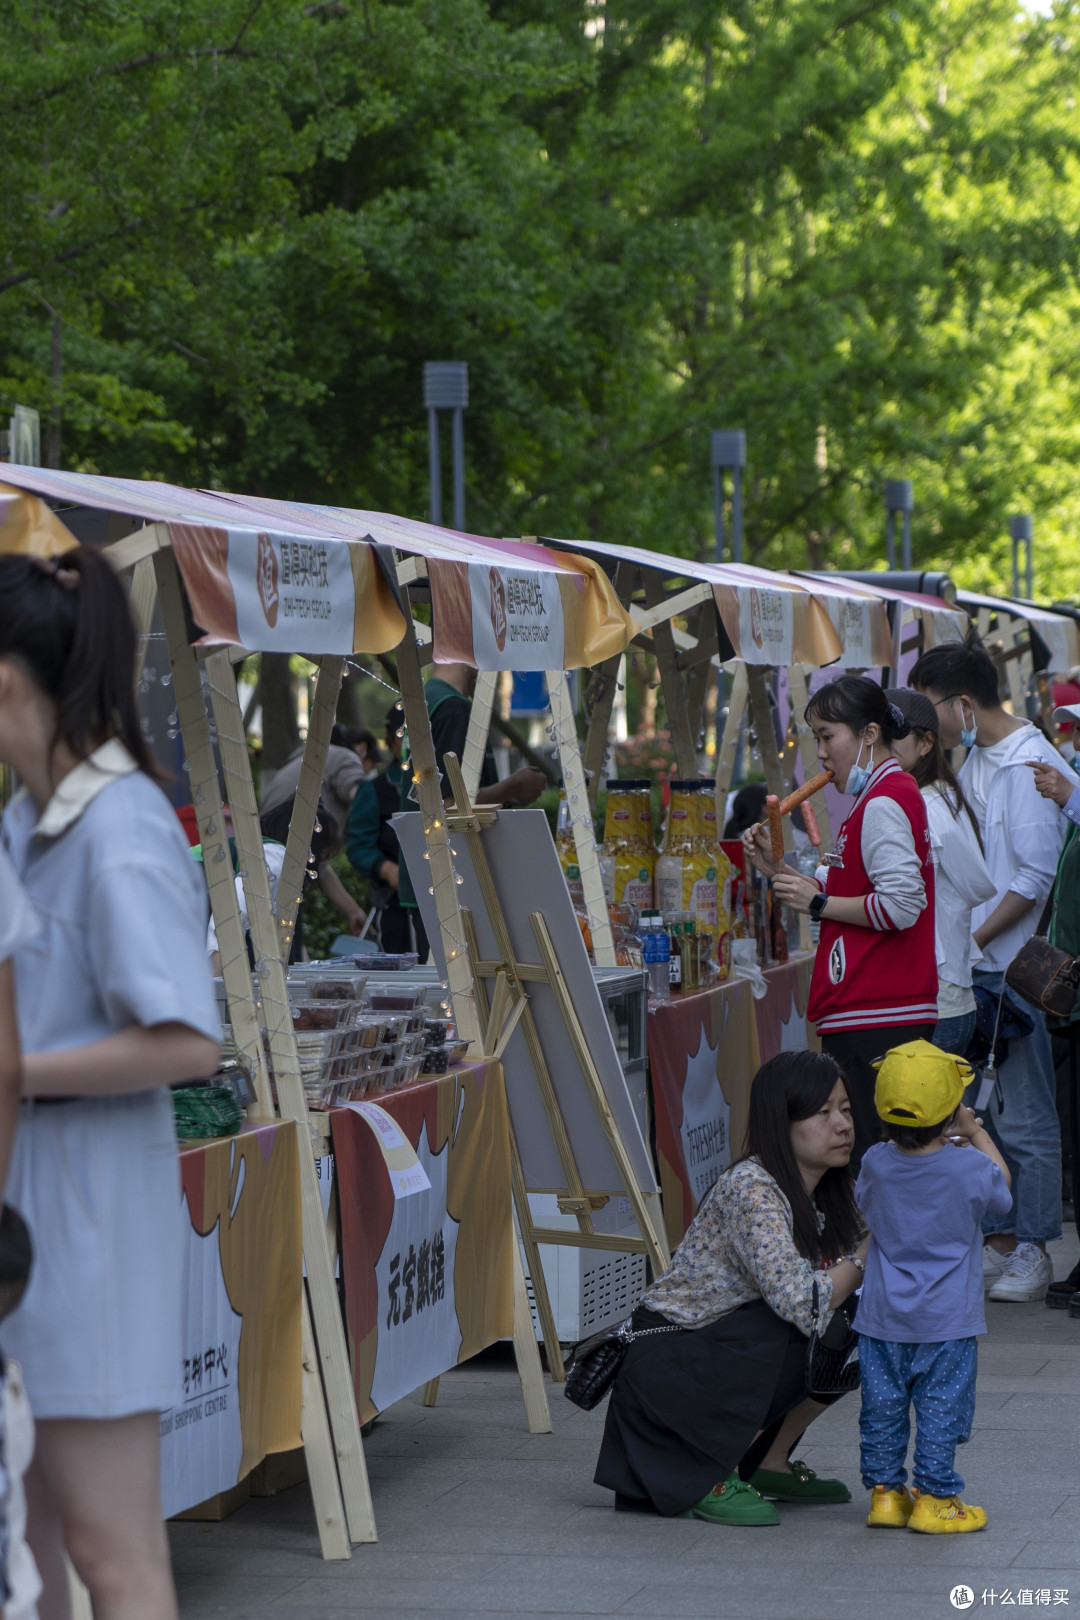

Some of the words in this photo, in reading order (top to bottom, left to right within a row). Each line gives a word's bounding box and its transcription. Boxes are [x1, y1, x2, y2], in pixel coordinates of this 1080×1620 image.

[281, 541, 329, 588] 值得买科技
[283, 597, 311, 619] ZHI-TECH
[311, 599, 332, 620] GROUP
[507, 576, 547, 616] 值得买科技
[510, 625, 532, 642] ZHI-TECH
[532, 625, 550, 643] GROUP
[174, 1403, 203, 1431] SHOPPING
[203, 1393, 228, 1417] CENTRE
